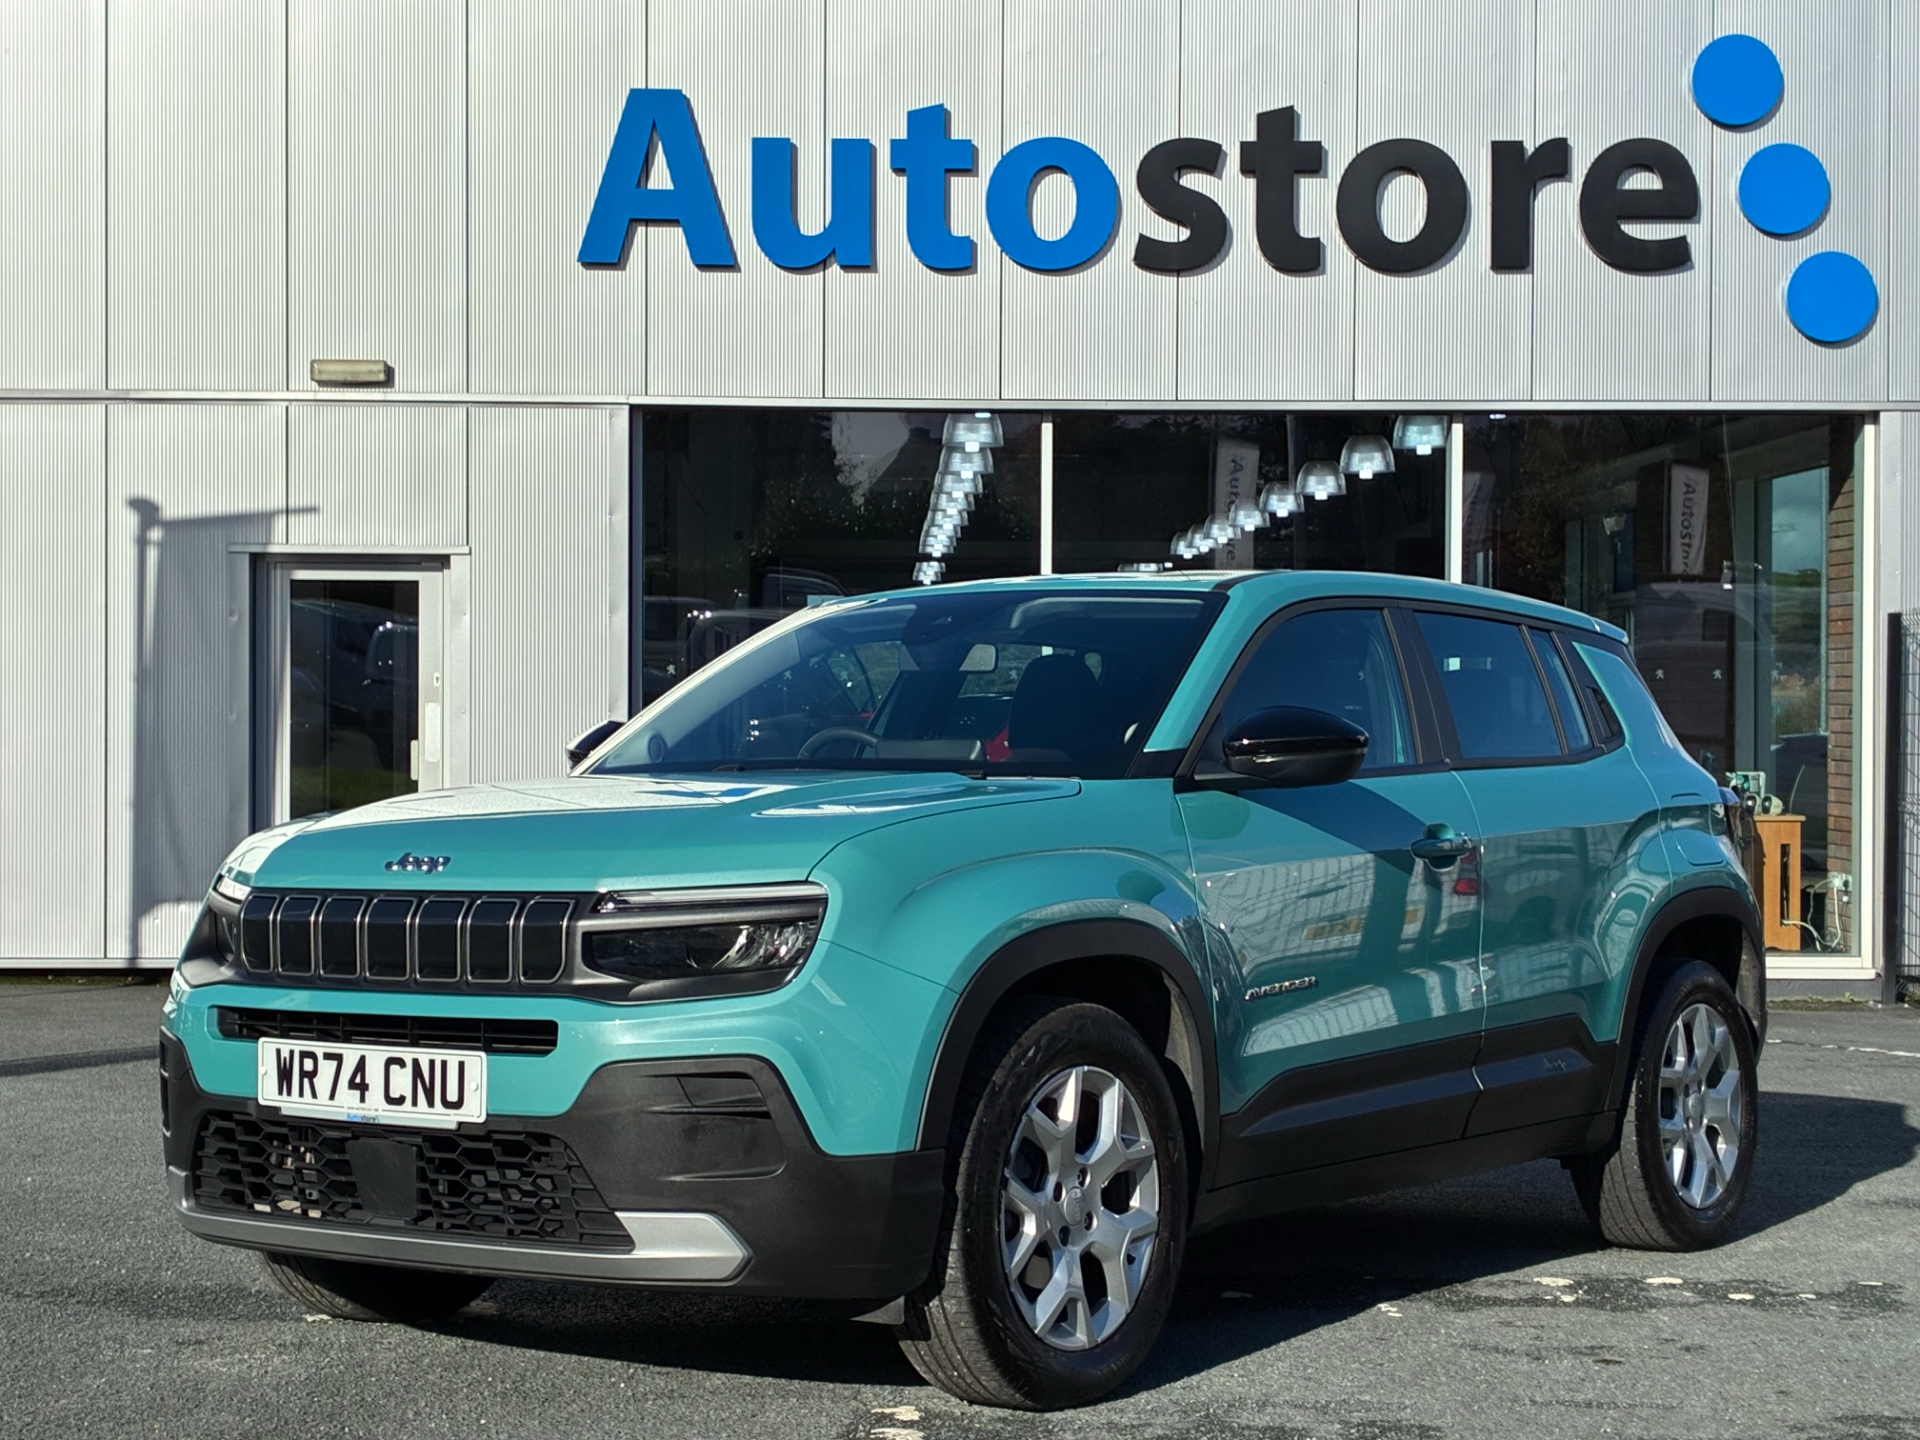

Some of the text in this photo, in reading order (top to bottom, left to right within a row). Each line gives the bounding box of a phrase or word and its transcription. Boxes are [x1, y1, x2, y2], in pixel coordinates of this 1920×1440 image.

[577, 88, 1699, 272] Autostore
[1226, 458, 1245, 561] Autore
[385, 852, 451, 874] Jeep
[275, 1048, 465, 1110] WR74 CNU
